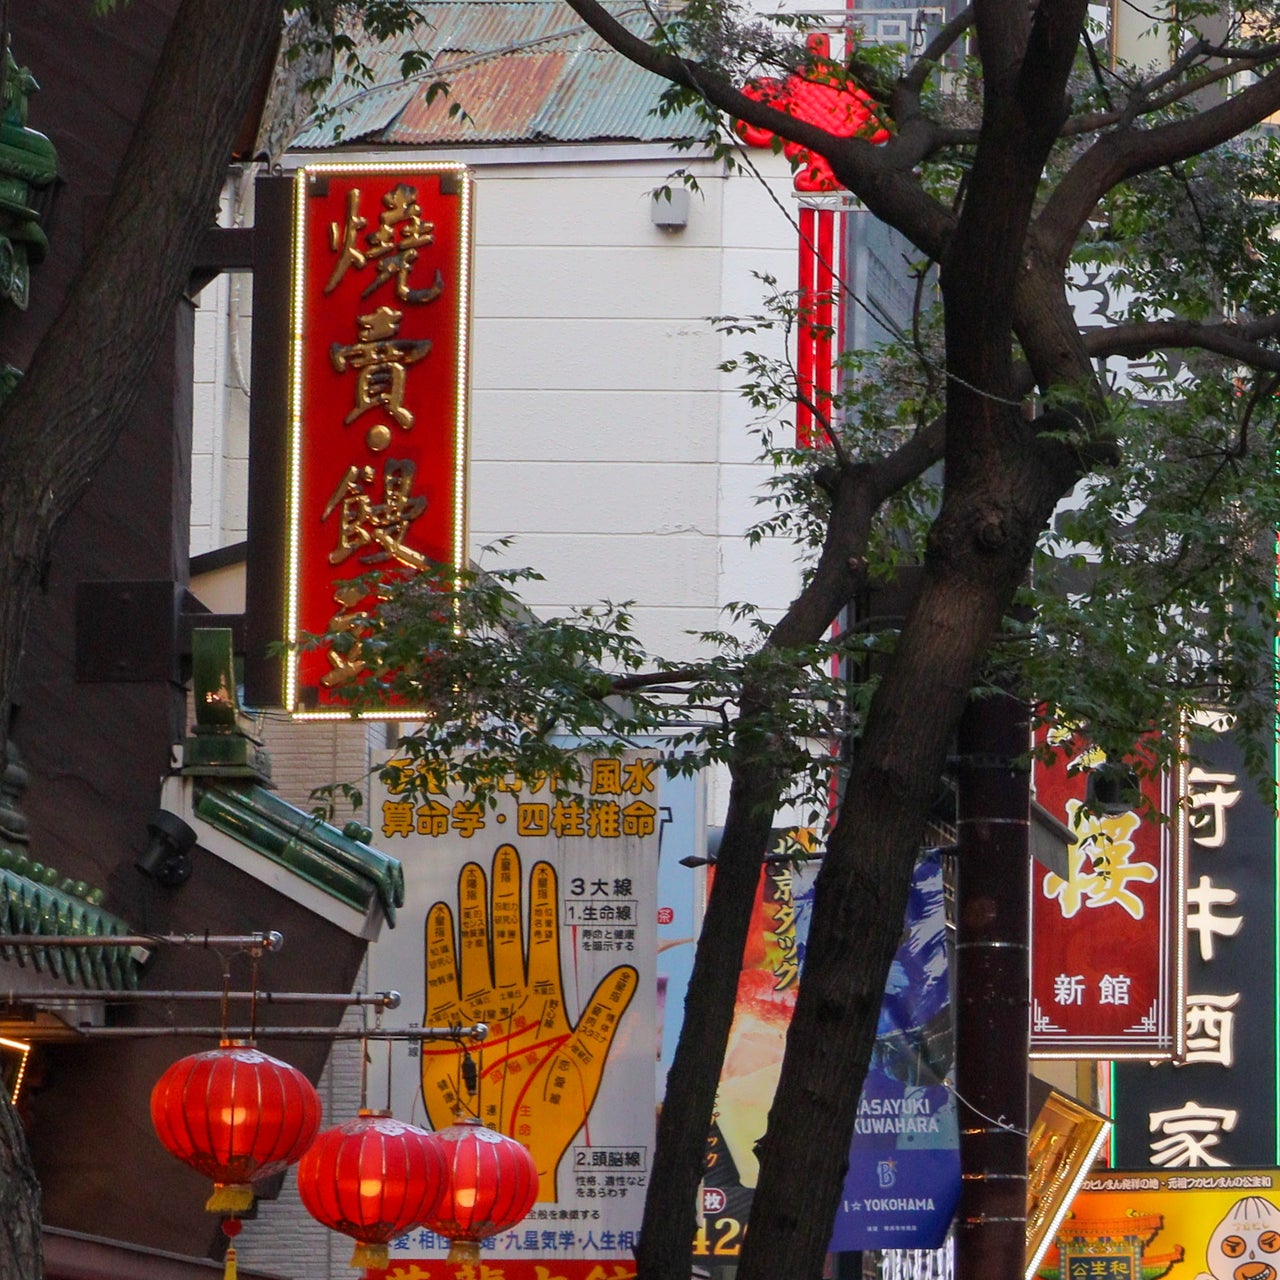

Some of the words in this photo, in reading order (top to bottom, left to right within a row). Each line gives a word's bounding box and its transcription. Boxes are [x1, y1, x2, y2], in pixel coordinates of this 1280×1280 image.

[382, 801, 656, 838] 算命学・四柱推命
[571, 879, 632, 896] 3大線
[568, 904, 632, 922] 1.生命線
[1054, 973, 1131, 1006] 新館
[857, 1099, 930, 1115] ASAYUKI
[576, 1152, 640, 1167] 2.頭脳線
[576, 1188, 629, 1198] をあらわす
[864, 1198, 936, 1211] YOKOHAMA
[692, 1217, 749, 1256] 42
